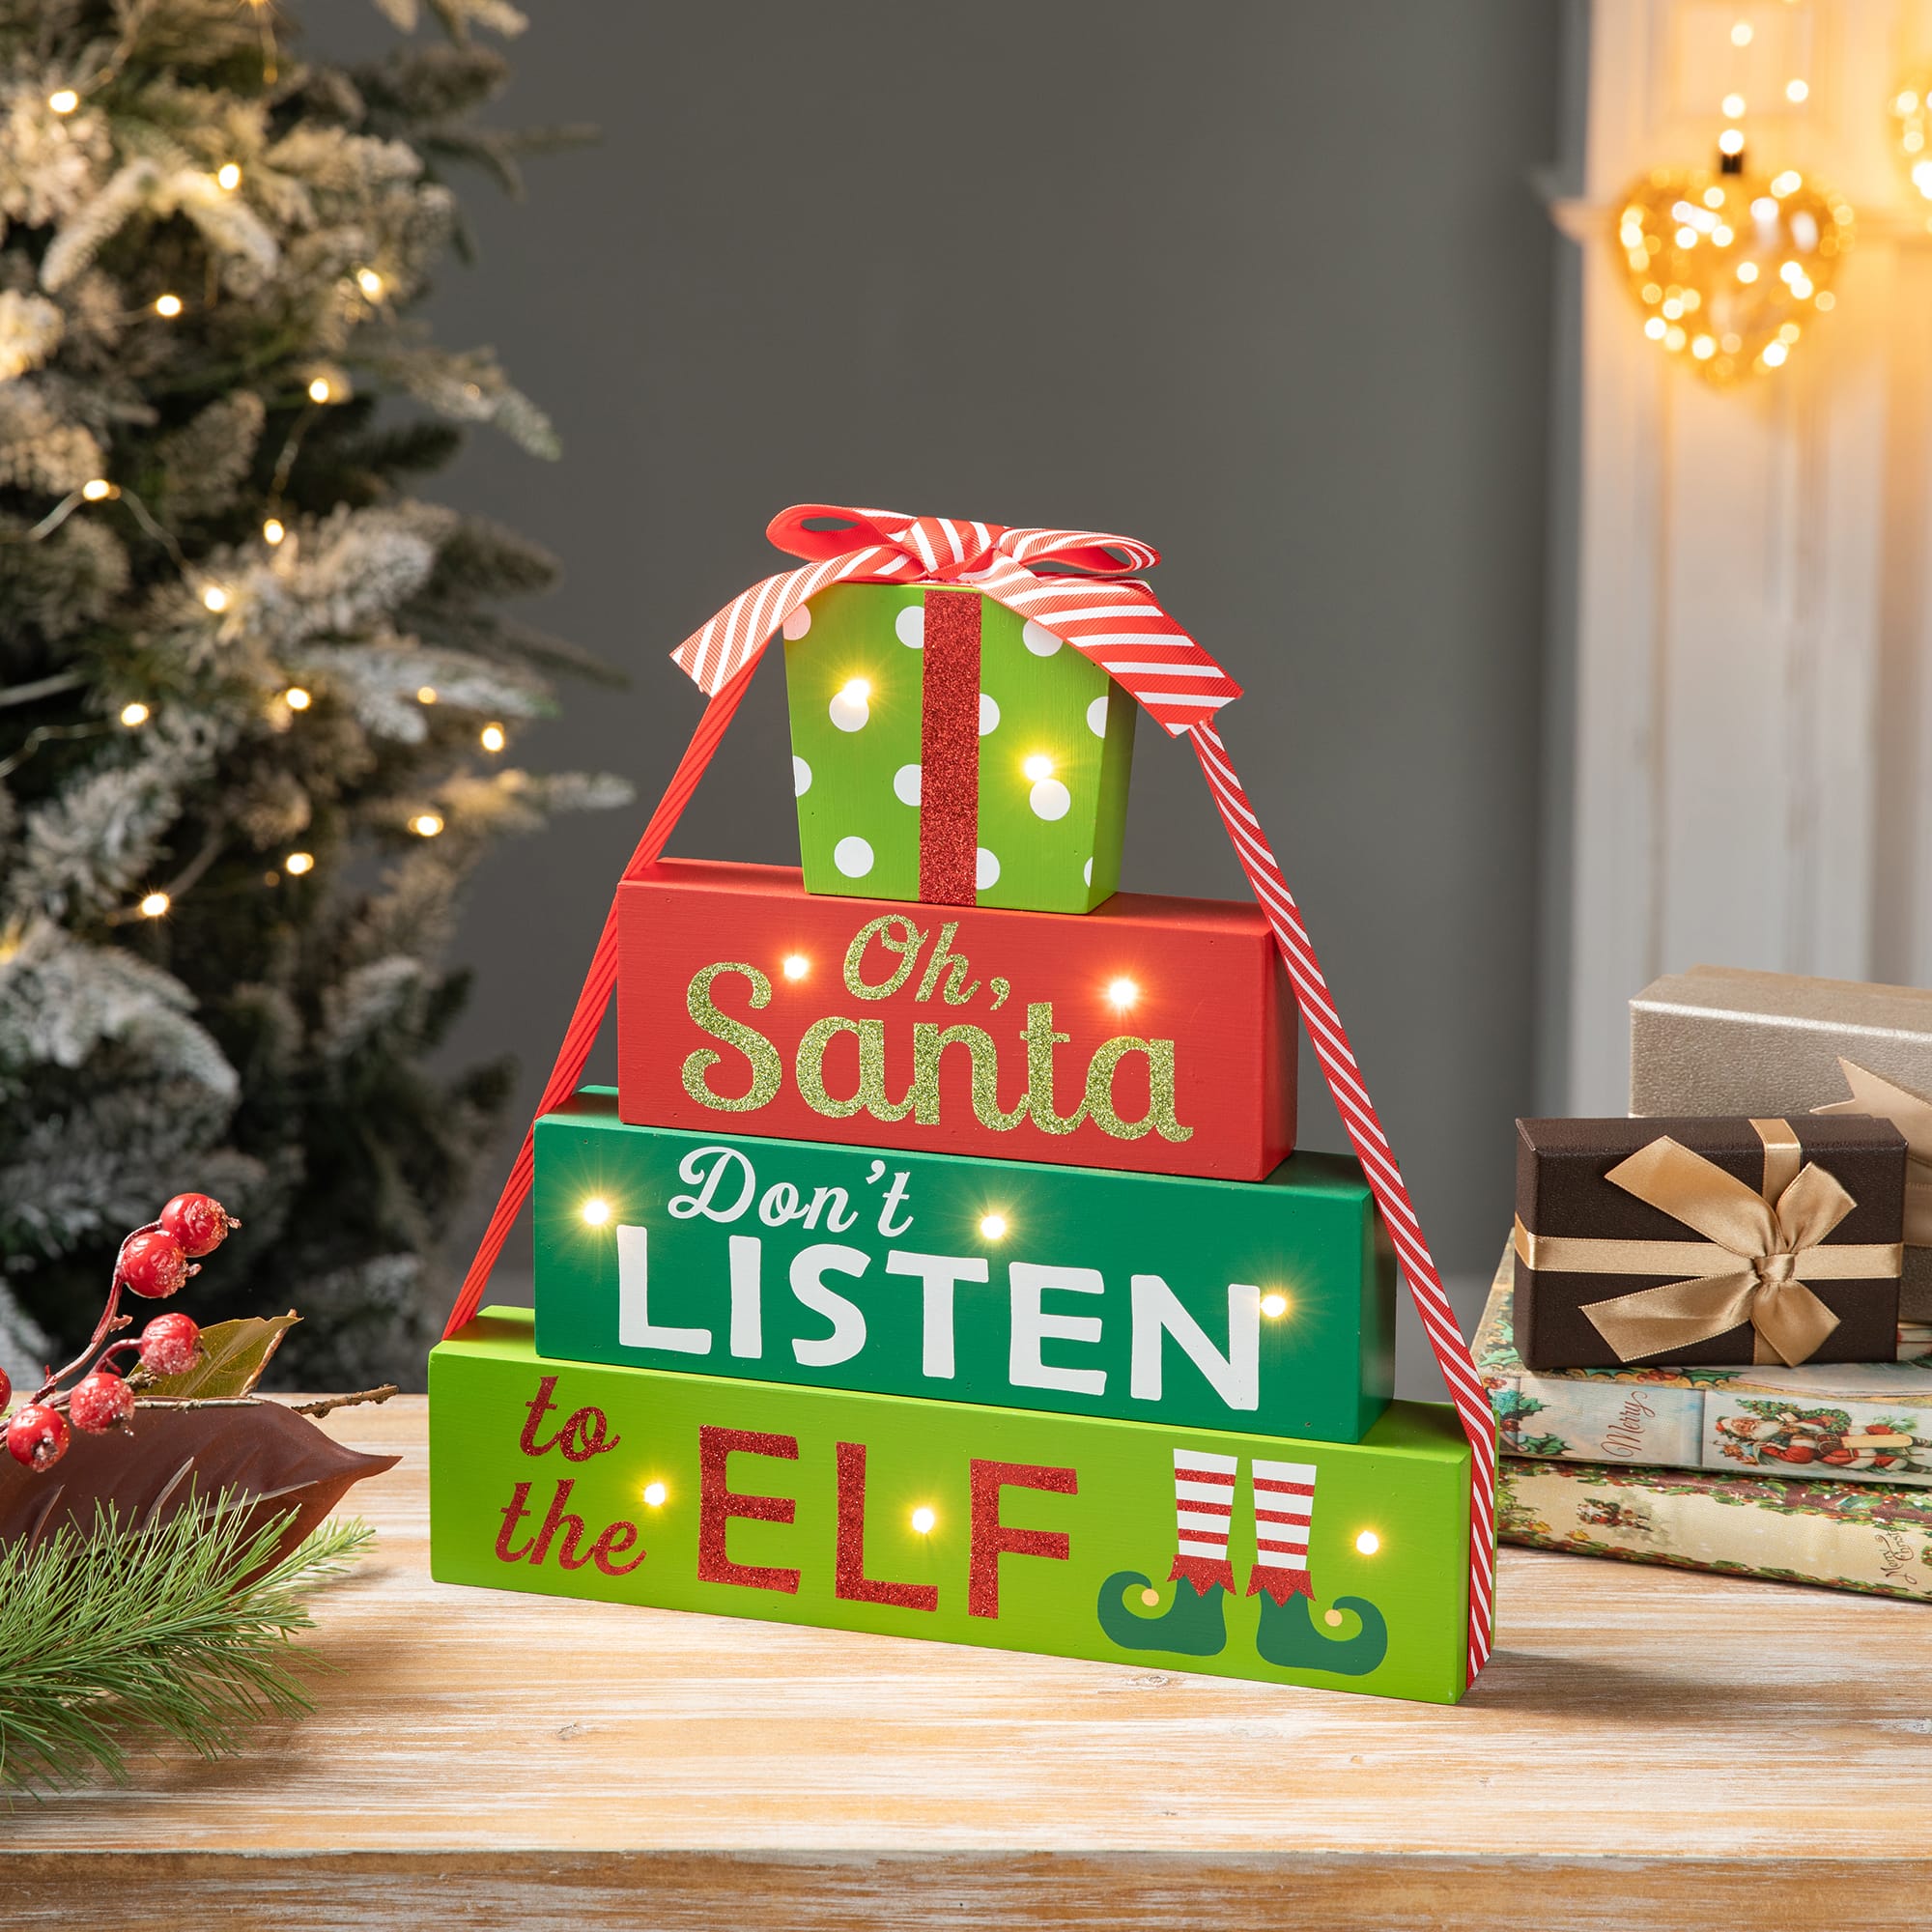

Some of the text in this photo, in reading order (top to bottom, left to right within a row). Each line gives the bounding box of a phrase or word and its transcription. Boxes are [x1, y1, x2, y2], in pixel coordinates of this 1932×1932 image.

[843, 914, 1010, 1010] Oh,
[681, 962, 1194, 1143] Santa
[668, 1146, 914, 1237] Don’t
[616, 1224, 1261, 1411] LISTEN
[518, 1375, 621, 1463] to
[1600, 1390, 1656, 1457] Merry
[495, 1478, 647, 1577] the
[697, 1424, 1079, 1620] ELF
